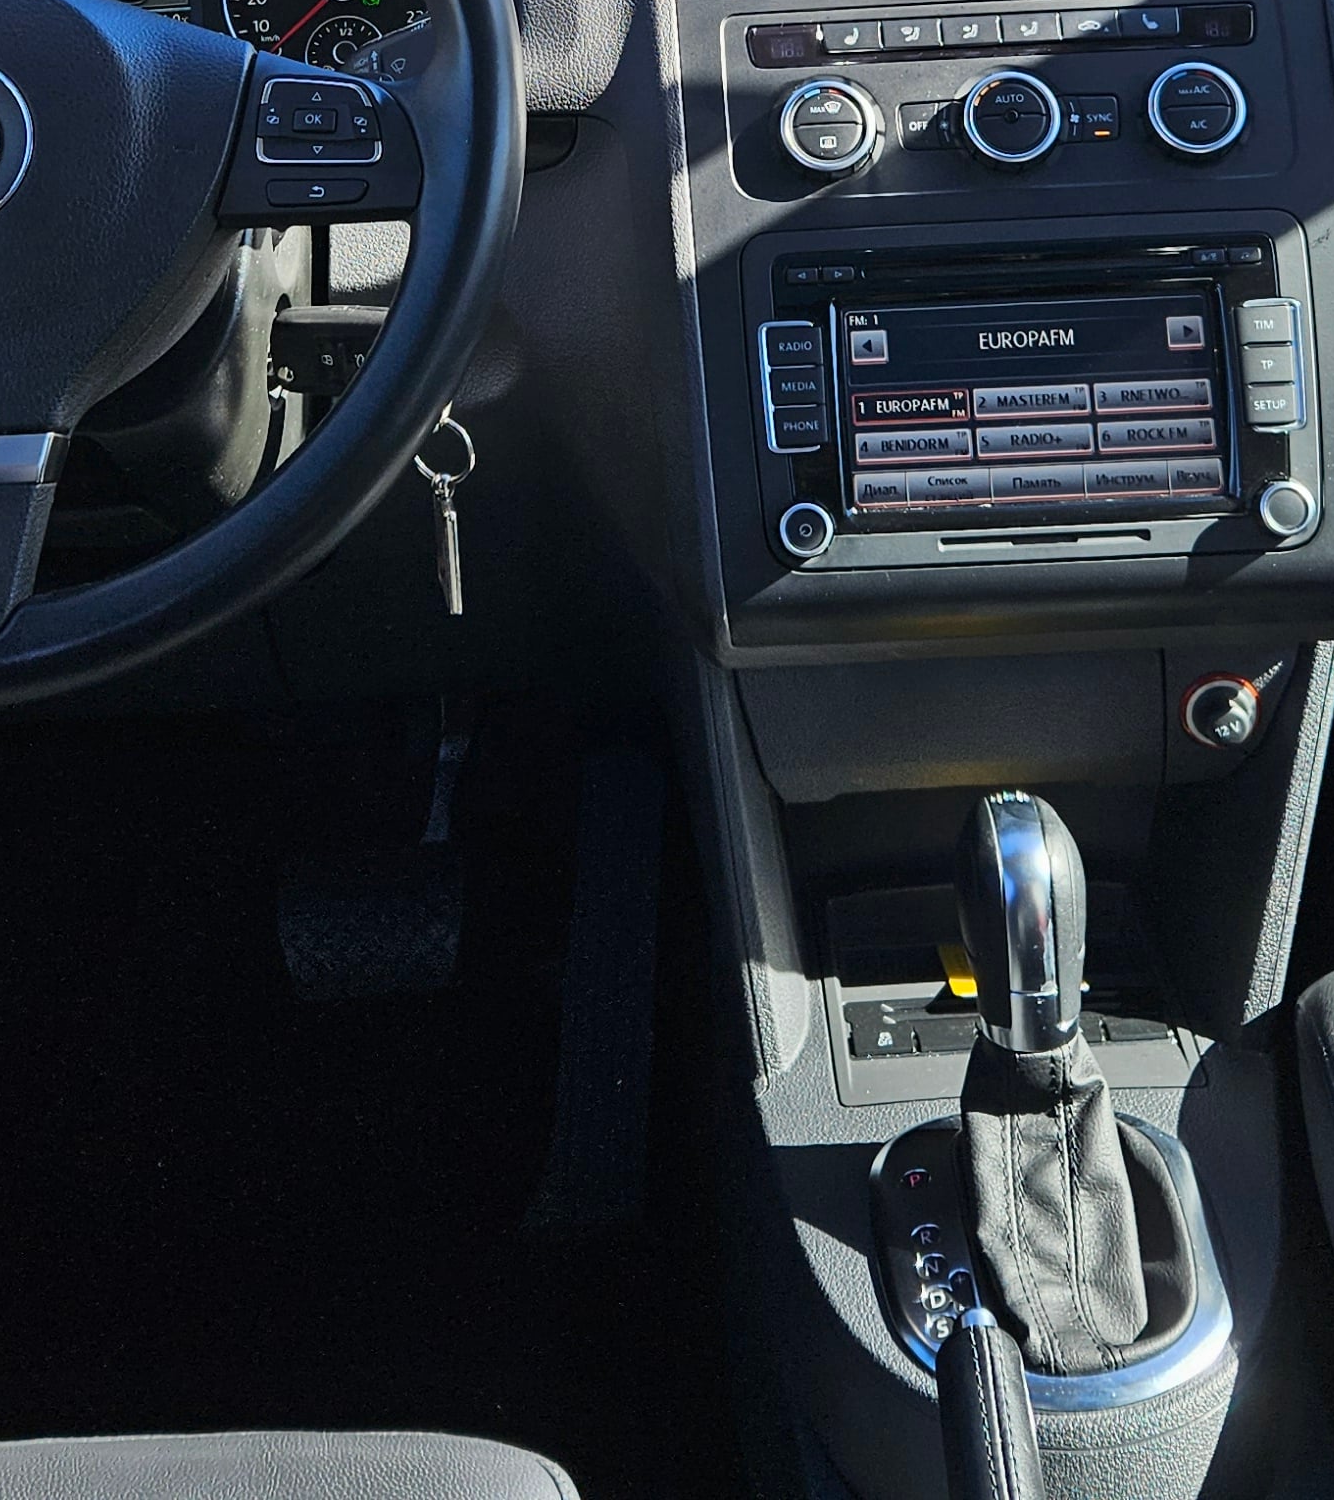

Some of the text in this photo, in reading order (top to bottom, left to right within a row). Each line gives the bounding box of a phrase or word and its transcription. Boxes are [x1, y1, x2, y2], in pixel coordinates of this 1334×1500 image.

[252, 20, 270, 33] 10
[339, 27, 353, 37] 1/2
[260, 34, 280, 43] km/h
[1193, 85, 1210, 94] A/C
[995, 93, 1024, 104] AUTO
[810, 105, 826, 114] MAX
[304, 114, 323, 125] OK
[1086, 113, 1113, 123] SYNC
[909, 121, 928, 131] OFF
[1190, 120, 1208, 129] A/C
[849, 315, 879, 326] FM: 1
[1254, 320, 1274, 330] TIM
[978, 328, 1075, 350] EUROPAFM
[779, 340, 813, 352] RADIO
[1261, 360, 1274, 370] TP
[781, 381, 817, 392] MEDIA
[1074, 386, 1085, 394] TP
[1196, 381, 1207, 389] TP
[953, 391, 964, 400] TP
[978, 392, 1070, 409] 2 MASTERFM
[1099, 391, 1107, 403] 3
[858, 397, 950, 414] 1 EUROPAFM
[1254, 400, 1286, 410] SETUP
[951, 409, 966, 419] FM
[783, 420, 820, 432] PHONE
[957, 431, 967, 439] TP
[981, 432, 1063, 448] 5 RADIO+
[1102, 427, 1188, 442] 6 ROCK FM
[860, 437, 949, 453] 4 BENIDORM
[927, 476, 968, 487] Список
[1012, 477, 1062, 489] Память
[1214, 720, 1240, 738] 12 V
[909, 1174, 921, 1188] P
[920, 1230, 932, 1245] R
[924, 1258, 940, 1277] N
[929, 1291, 946, 1309] D
[936, 1316, 950, 1338] S
